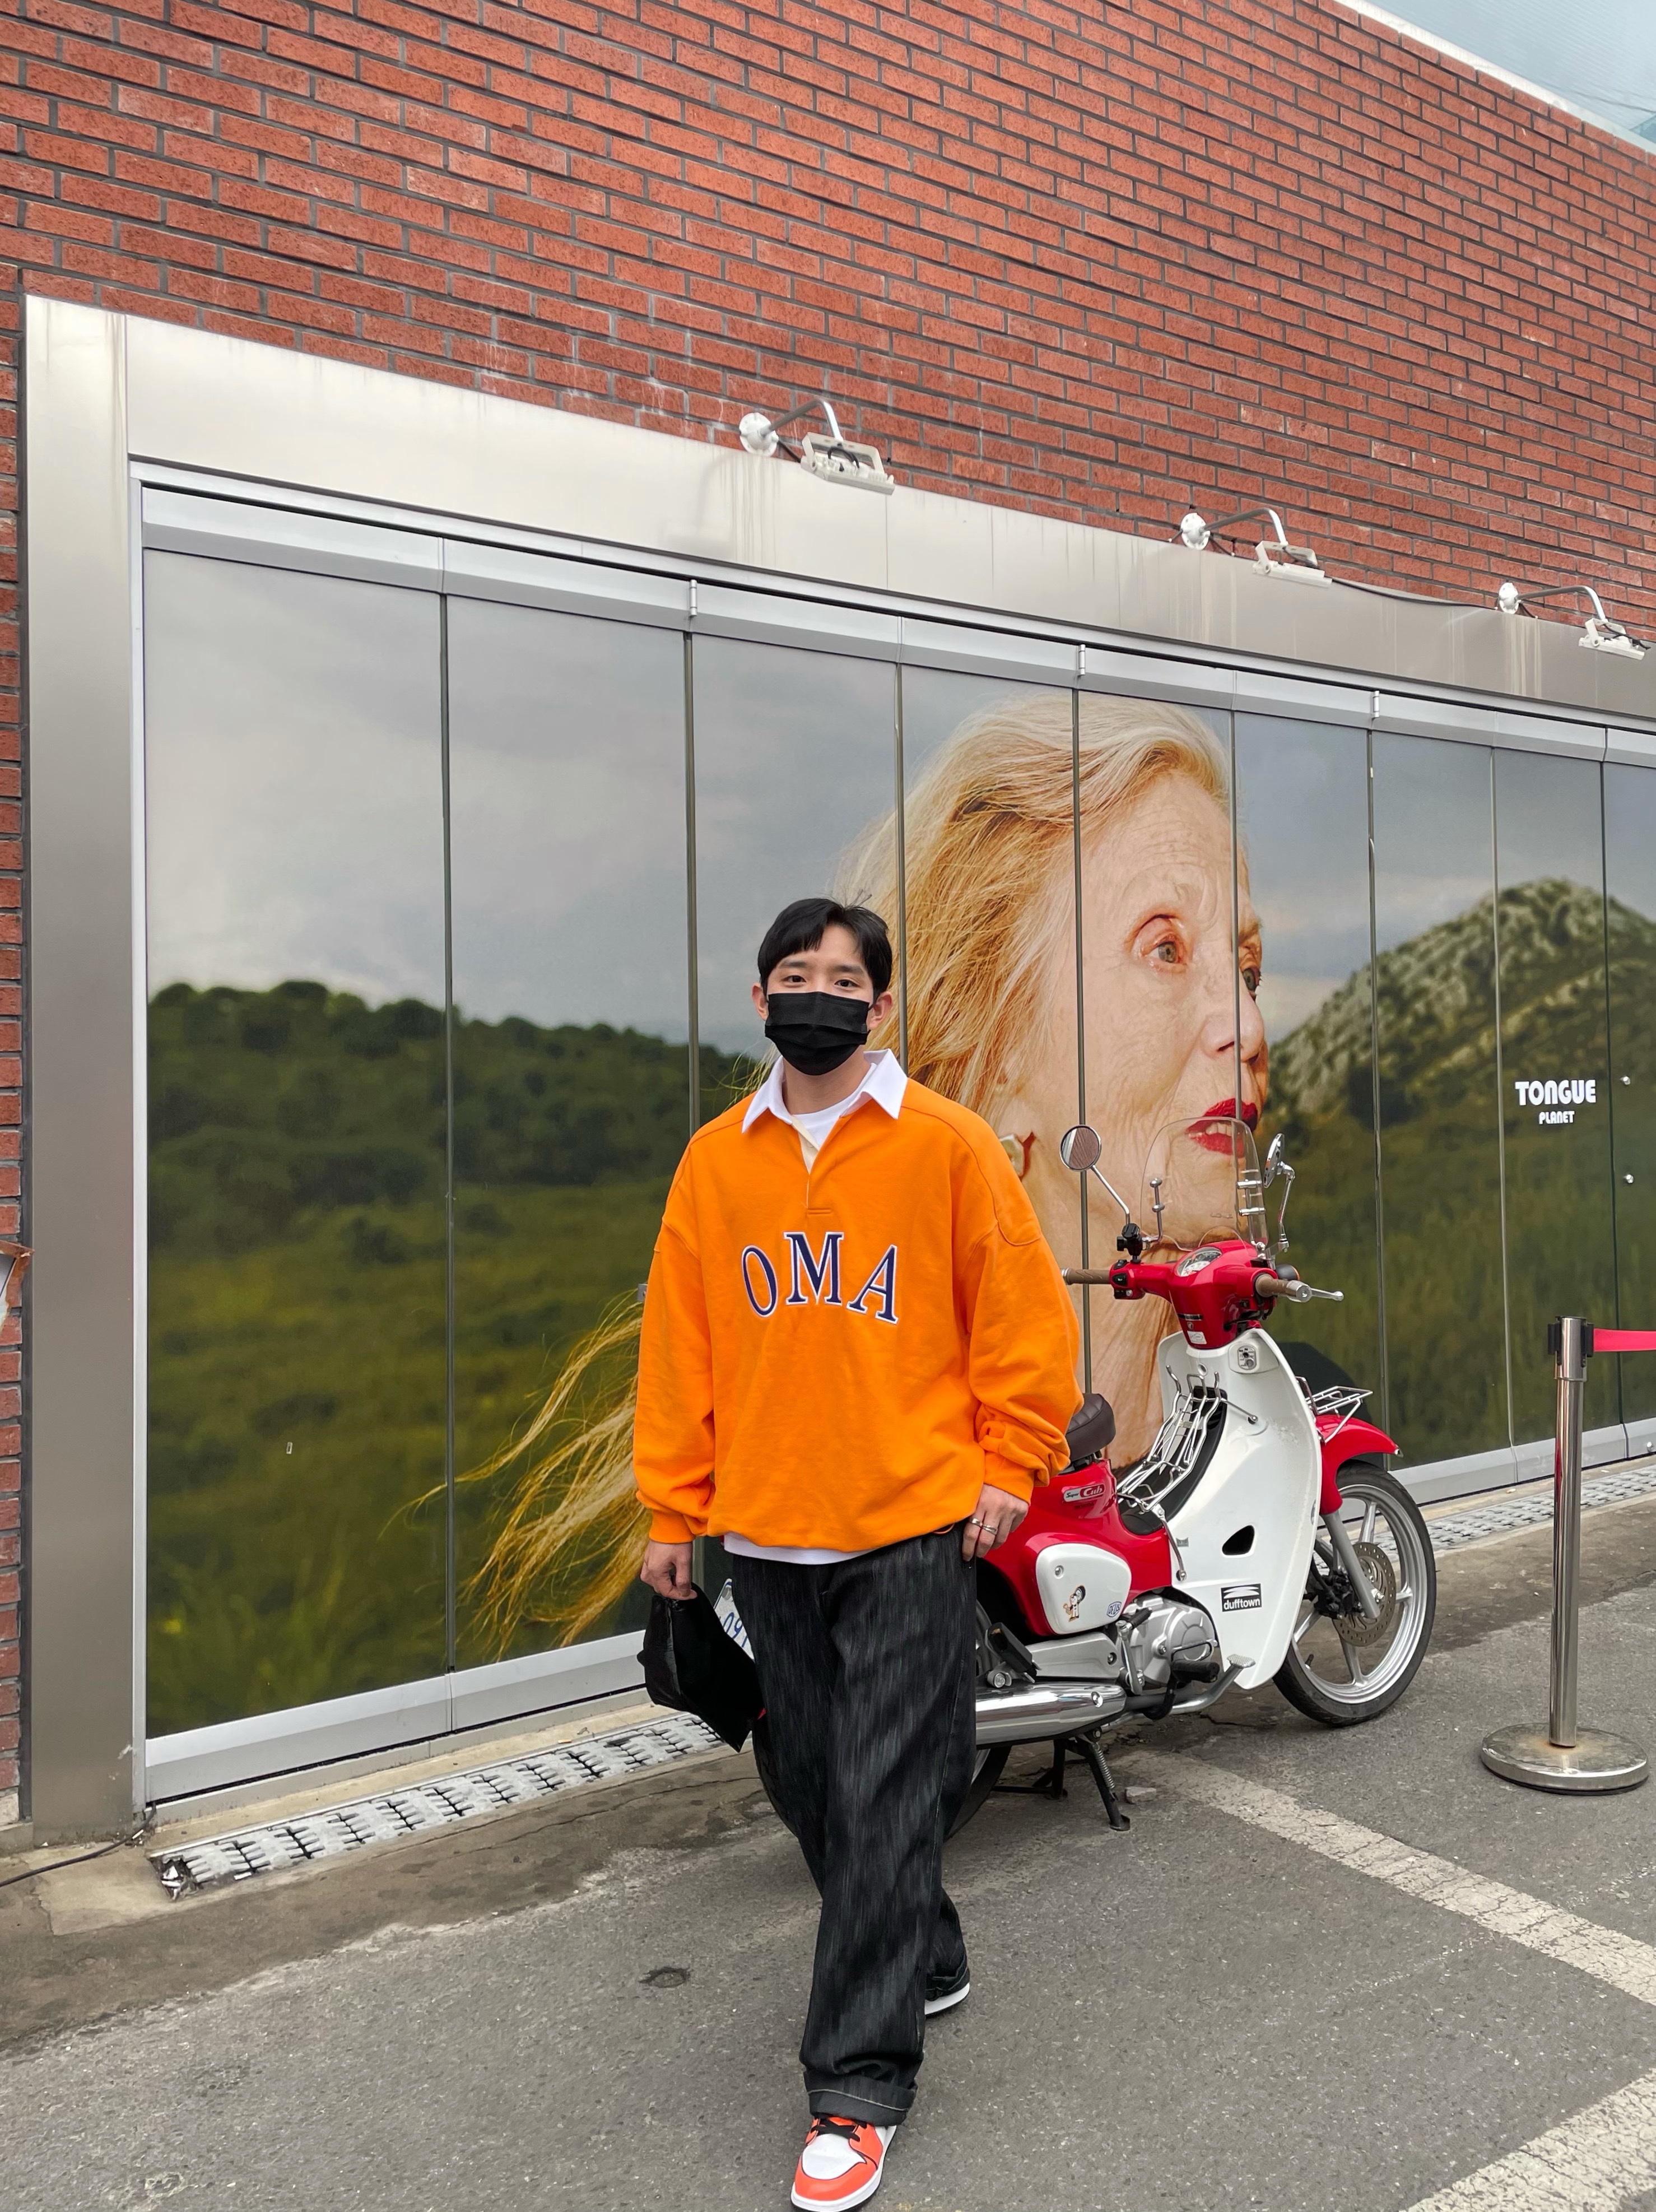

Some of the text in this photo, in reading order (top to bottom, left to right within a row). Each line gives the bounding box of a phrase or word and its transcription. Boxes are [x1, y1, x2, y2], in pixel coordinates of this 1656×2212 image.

[1515, 1079, 1596, 1105] TONGUE
[1539, 1110, 1575, 1124] PLANET
[741, 1232, 899, 1325] OMA
[1083, 1485, 1103, 1497] Cub
[1224, 1598, 1260, 1610] dufftown
